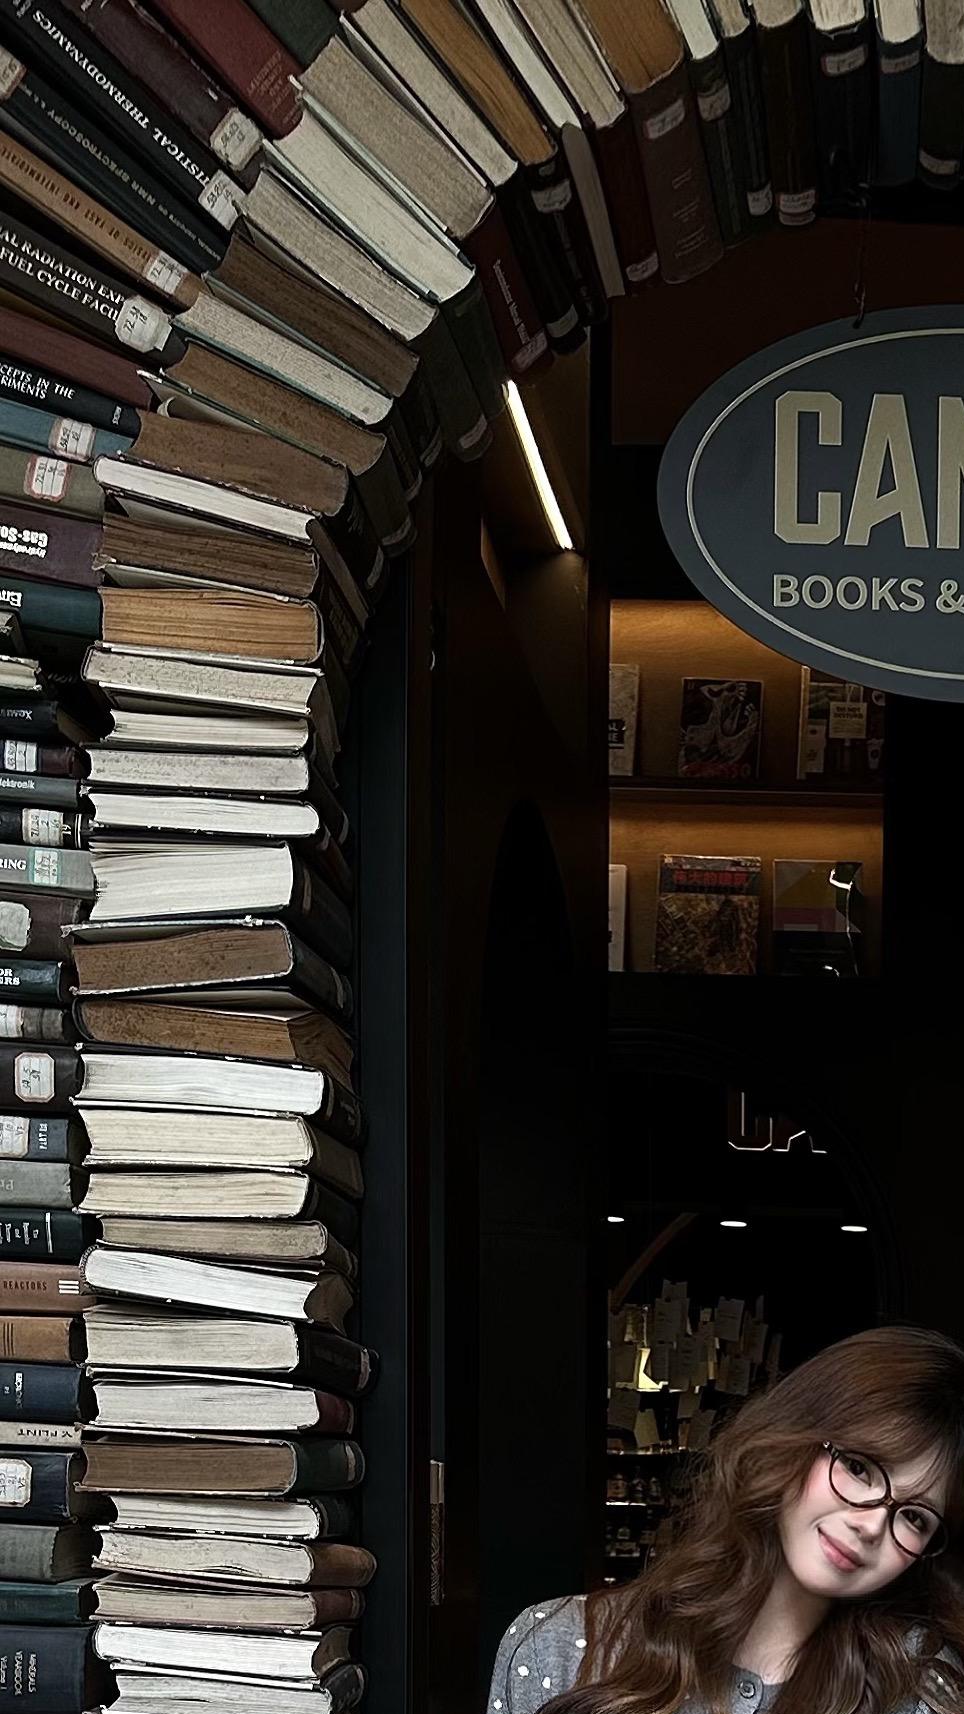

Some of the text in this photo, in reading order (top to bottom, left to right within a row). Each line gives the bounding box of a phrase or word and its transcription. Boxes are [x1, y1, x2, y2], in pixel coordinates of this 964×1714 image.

[33, 9, 150, 129] THERMODYNAMICS
[47, 108, 131, 184] SPECTROSCOPY
[20, 240, 98, 292] RADIATION
[37, 269, 82, 301] CYCLE
[37, 376, 51, 391] IN
[54, 383, 77, 400] THE
[773, 573, 925, 613] BOOKS
[3, 1279, 48, 1291] REACTORS
[14, 1650, 23, 1696] YEARBOOK
